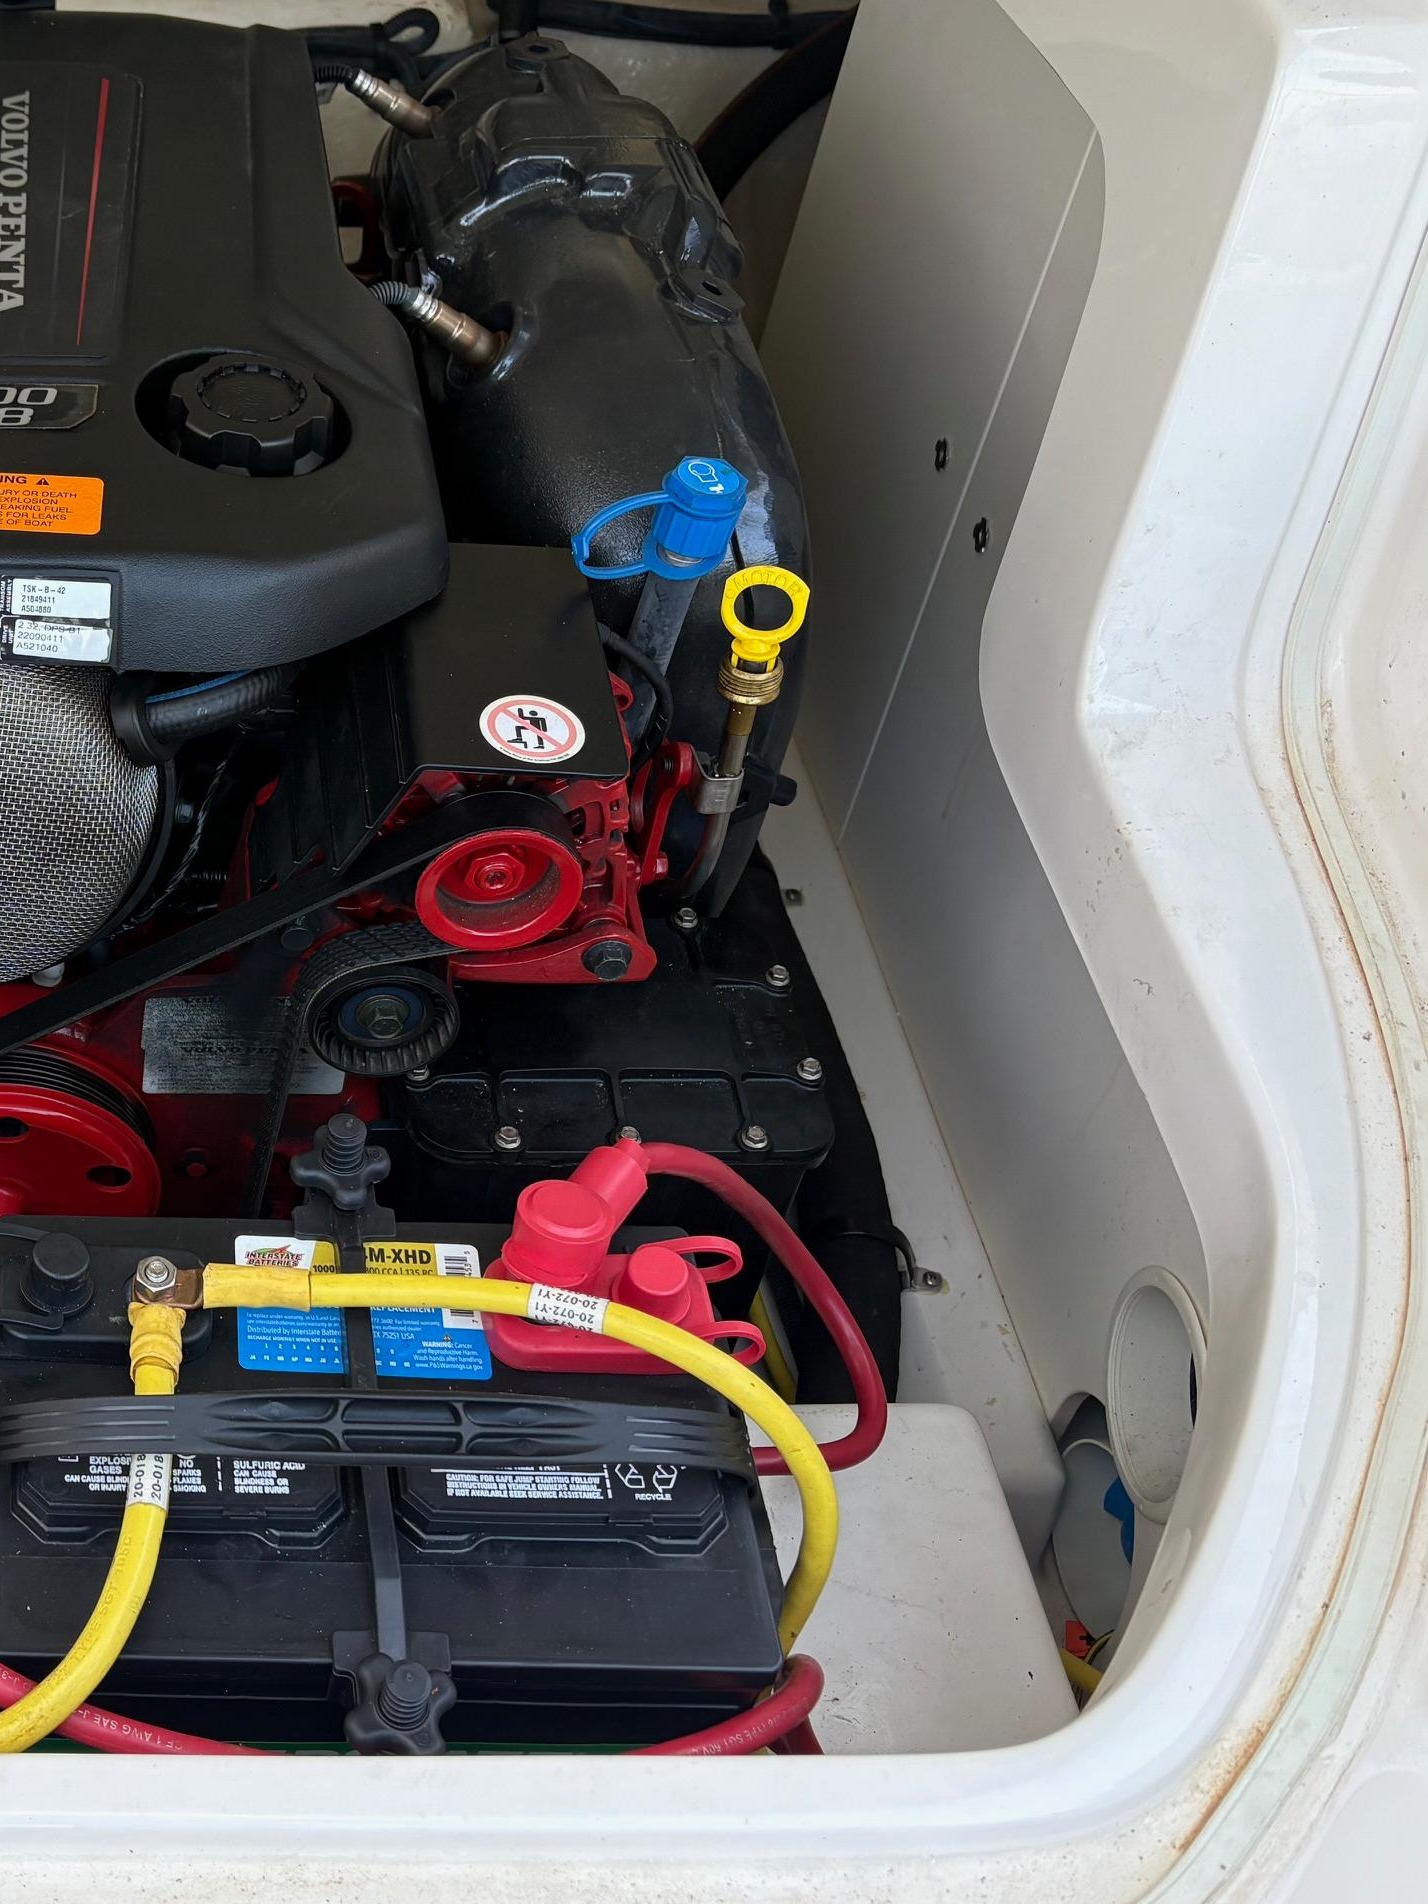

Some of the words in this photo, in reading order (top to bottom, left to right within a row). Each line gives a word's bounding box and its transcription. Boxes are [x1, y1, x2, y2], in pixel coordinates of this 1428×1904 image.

[0, 91, 30, 188] VOLVO
[22, 489, 39, 497] OR
[41, 491, 77, 499] DEATH
[6, 510, 29, 519] FOR
[32, 512, 67, 521] LEAKS
[5, 518, 22, 526] OF
[25, 519, 54, 527] BOAT
[733, 569, 803, 598] MOTOR
[17, 631, 63, 643] 22090411
[16, 641, 59, 653] A521040
[244, 1251, 303, 1260] INTERSTATE
[246, 1259, 300, 1267] BATTERIES
[312, 1265, 335, 1273] 1000
[538, 1288, 598, 1310] 20-072-Y1
[534, 1301, 595, 1324] 20-072-Y1
[247, 1325, 282, 1335] Distributed
[282, 1328, 290, 1336] by
[291, 1328, 321, 1336] Interstate
[401, 1332, 415, 1340] USA
[89, 1456, 131, 1466] EXPLOSI
[179, 1459, 194, 1468] NO
[233, 1460, 281, 1470] SULFURIC
[282, 1462, 306, 1471] ACID
[89, 1465, 122, 1475] GASES
[172, 1469, 202, 1477] SPARKS
[233, 1469, 250, 1477] CAN
[251, 1469, 277, 1478] CAUSE
[64, 1474, 80, 1482] CAN
[80, 1475, 106, 1483] CAUSE
[172, 1477, 202, 1485] FLAMES
[234, 1478, 276, 1486] BLINDNESS
[277, 1478, 289, 1486] OR
[446, 1474, 479, 1482] CAUTION:
[479, 1474, 494, 1482] FOR
[495, 1474, 514, 1483] SAFE
[514, 1475, 534, 1483] JUMP
[535, 1476, 570, 1484] STARTING
[570, 1476, 600, 1484] FOLLOW
[89, 1483, 101, 1491] OR
[100, 1484, 127, 1492] INJURY
[172, 1485, 207, 1493] SMOKING
[234, 1486, 263, 1494] SEVERE
[264, 1486, 290, 1494] BURNS
[446, 1481, 498, 1490] INSTRUCTIONS
[498, 1482, 507, 1490] IN
[508, 1482, 536, 1490] VEHICLE
[537, 1483, 568, 1491] OWNERS
[454, 1489, 470, 1497] NOT
[470, 1489, 508, 1498] AVAILABLE
[509, 1490, 527, 1498] SEEK
[527, 1490, 558, 1499] SERVICE
[98, 1581, 119, 1616] SGT
[92, 1713, 118, 1731] SAE
[122, 1724, 153, 1743] AWG
